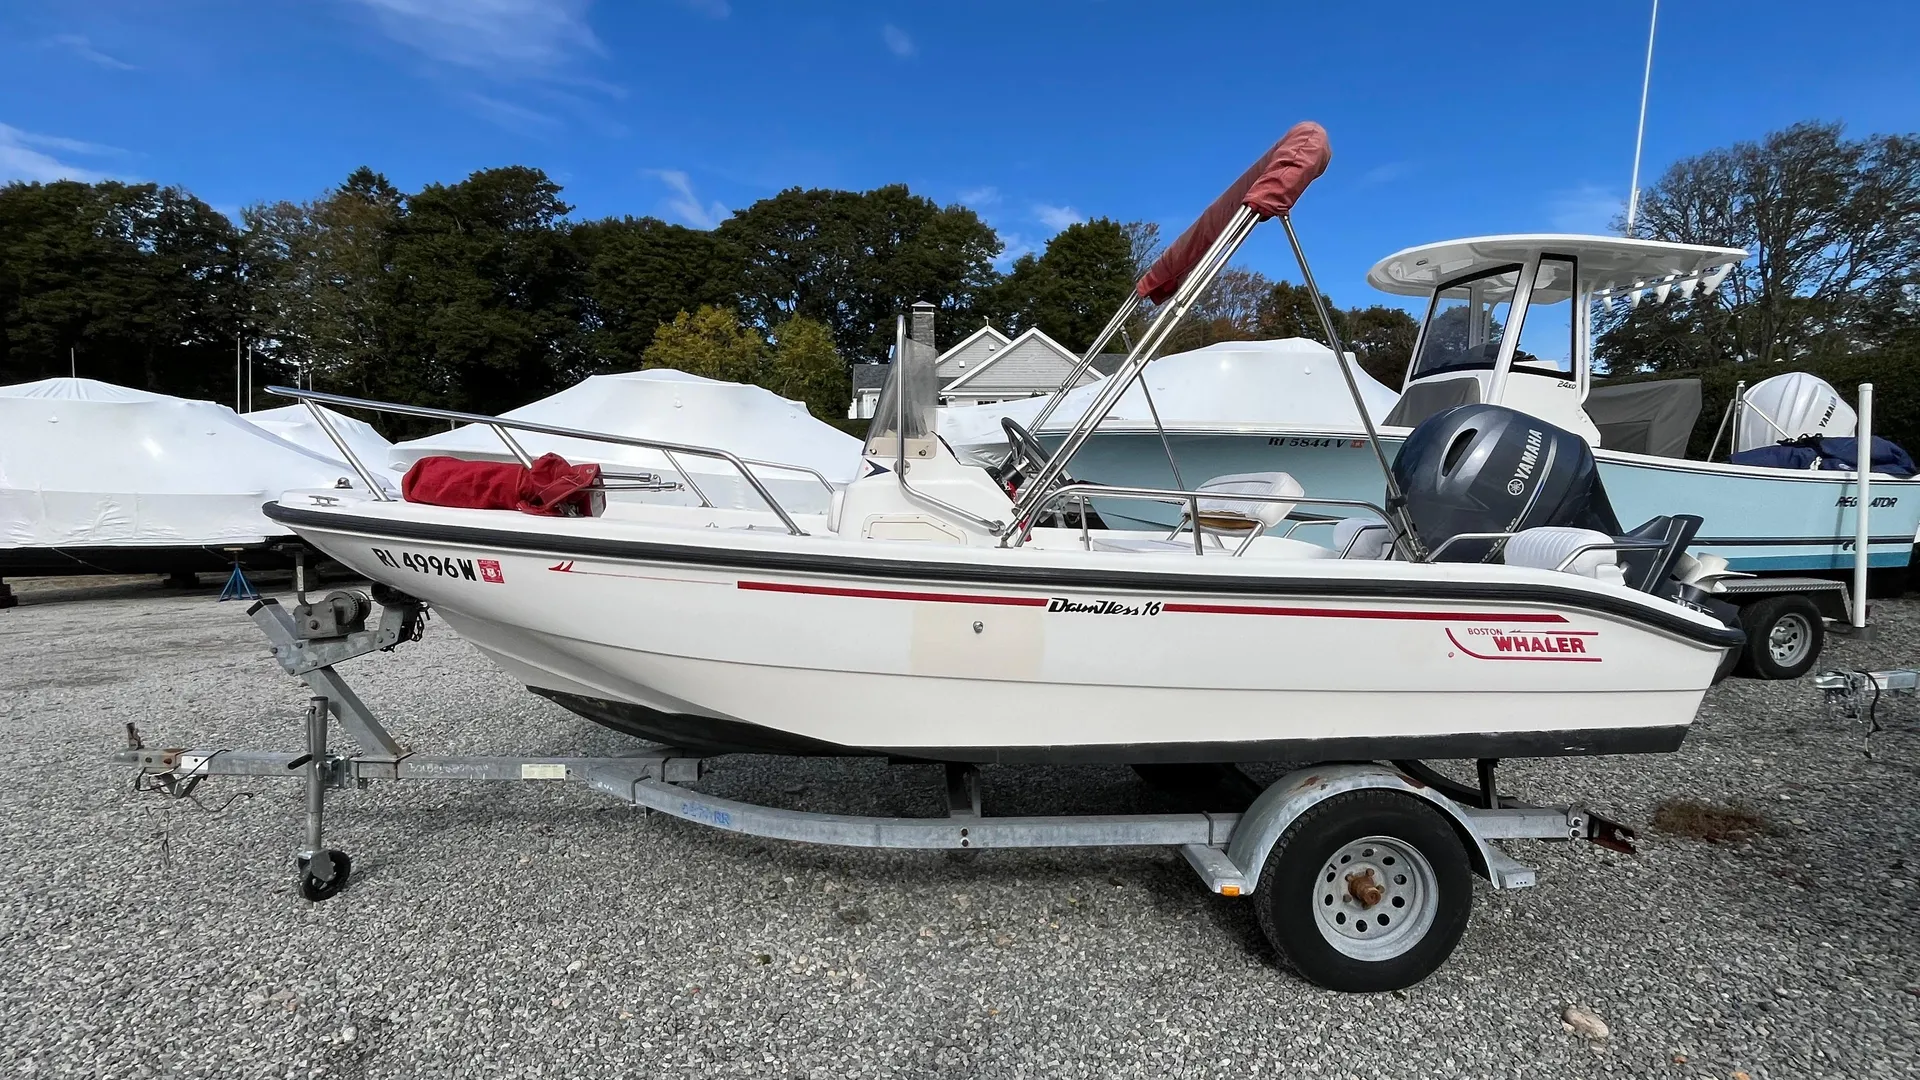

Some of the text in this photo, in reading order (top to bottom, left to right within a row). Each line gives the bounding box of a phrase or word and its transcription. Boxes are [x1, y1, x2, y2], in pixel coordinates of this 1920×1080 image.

[1268, 437, 1286, 446] RI
[1289, 438, 1330, 448] 5844
[1336, 439, 1347, 448] V
[1514, 429, 1543, 480] YAMAHA
[1835, 496, 1898, 507] REGATOR
[371, 548, 400, 569] RI
[1048, 597, 1161, 615] Dauntless 16
[1467, 627, 1503, 636] BOSTON
[1492, 636, 1586, 653] WHALER
